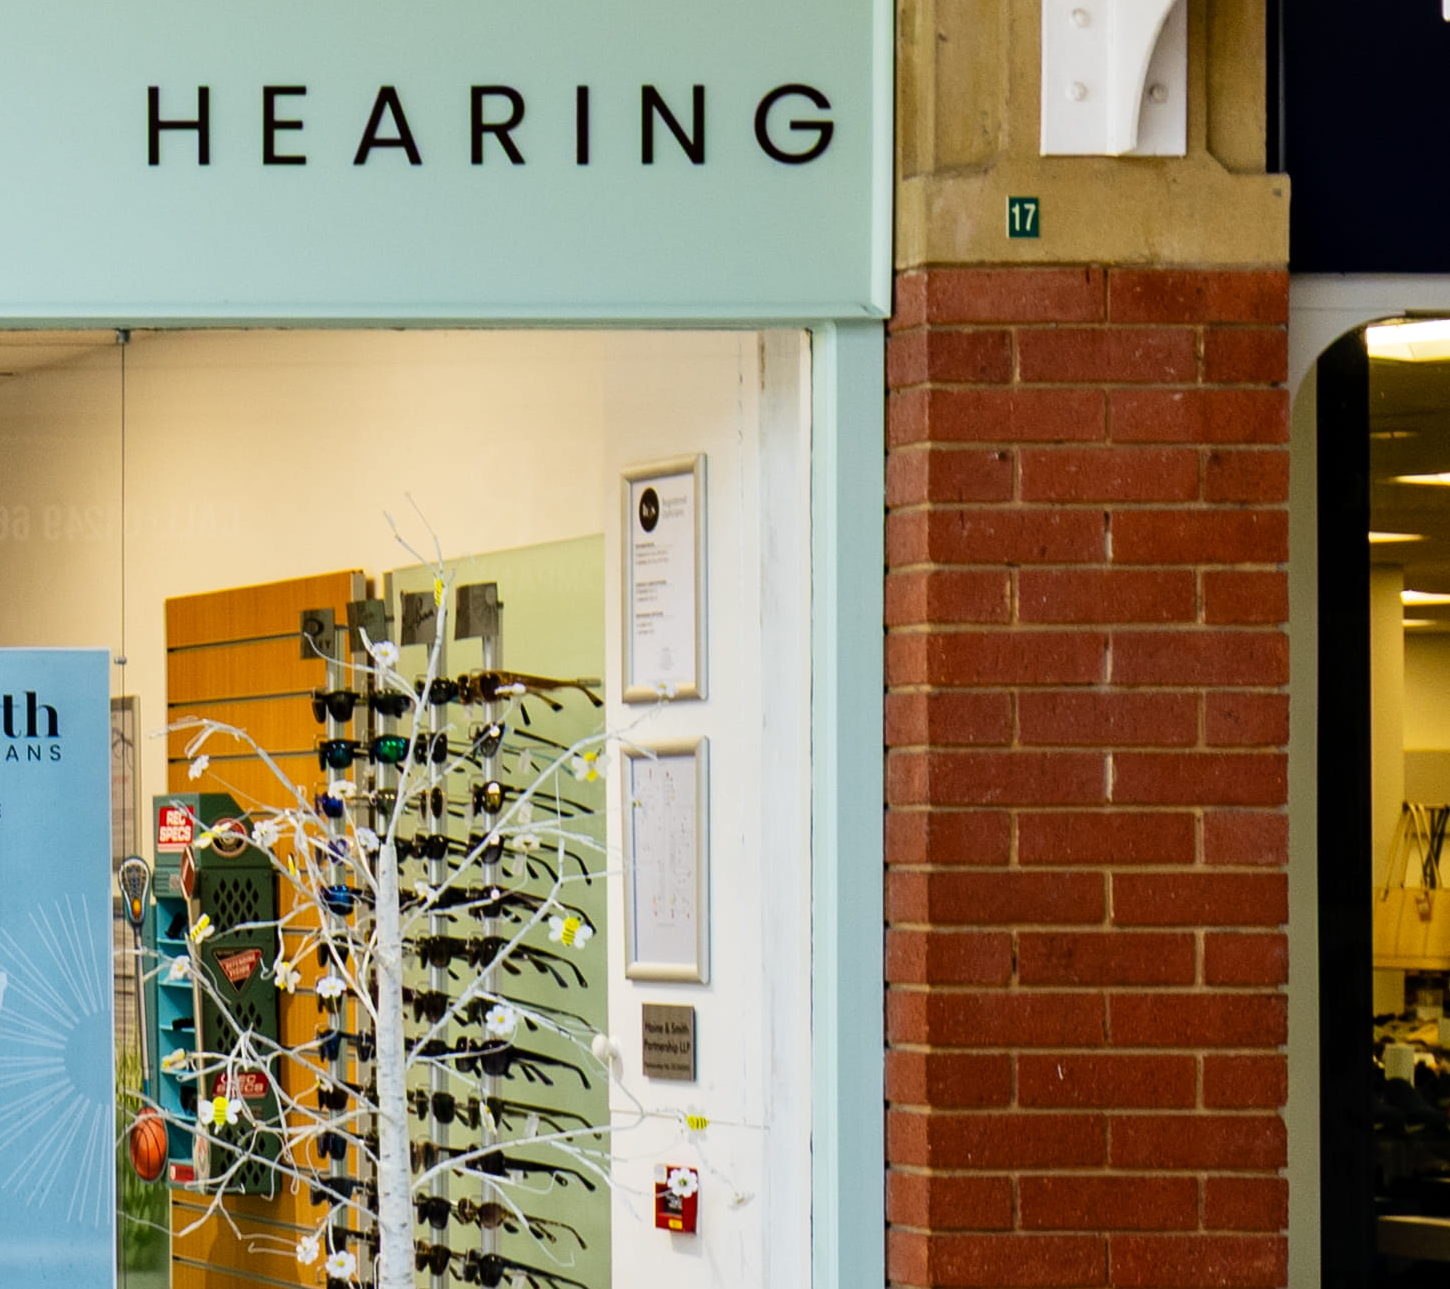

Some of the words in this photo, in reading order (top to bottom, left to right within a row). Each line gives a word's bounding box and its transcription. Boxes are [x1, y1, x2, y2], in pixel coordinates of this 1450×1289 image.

[148, 84, 836, 167] HEARING
[1012, 204, 1036, 231] 17
[159, 825, 192, 842] SPECS
[671, 1023, 690, 1035] Smith
[643, 1039, 678, 1054] Partnership
